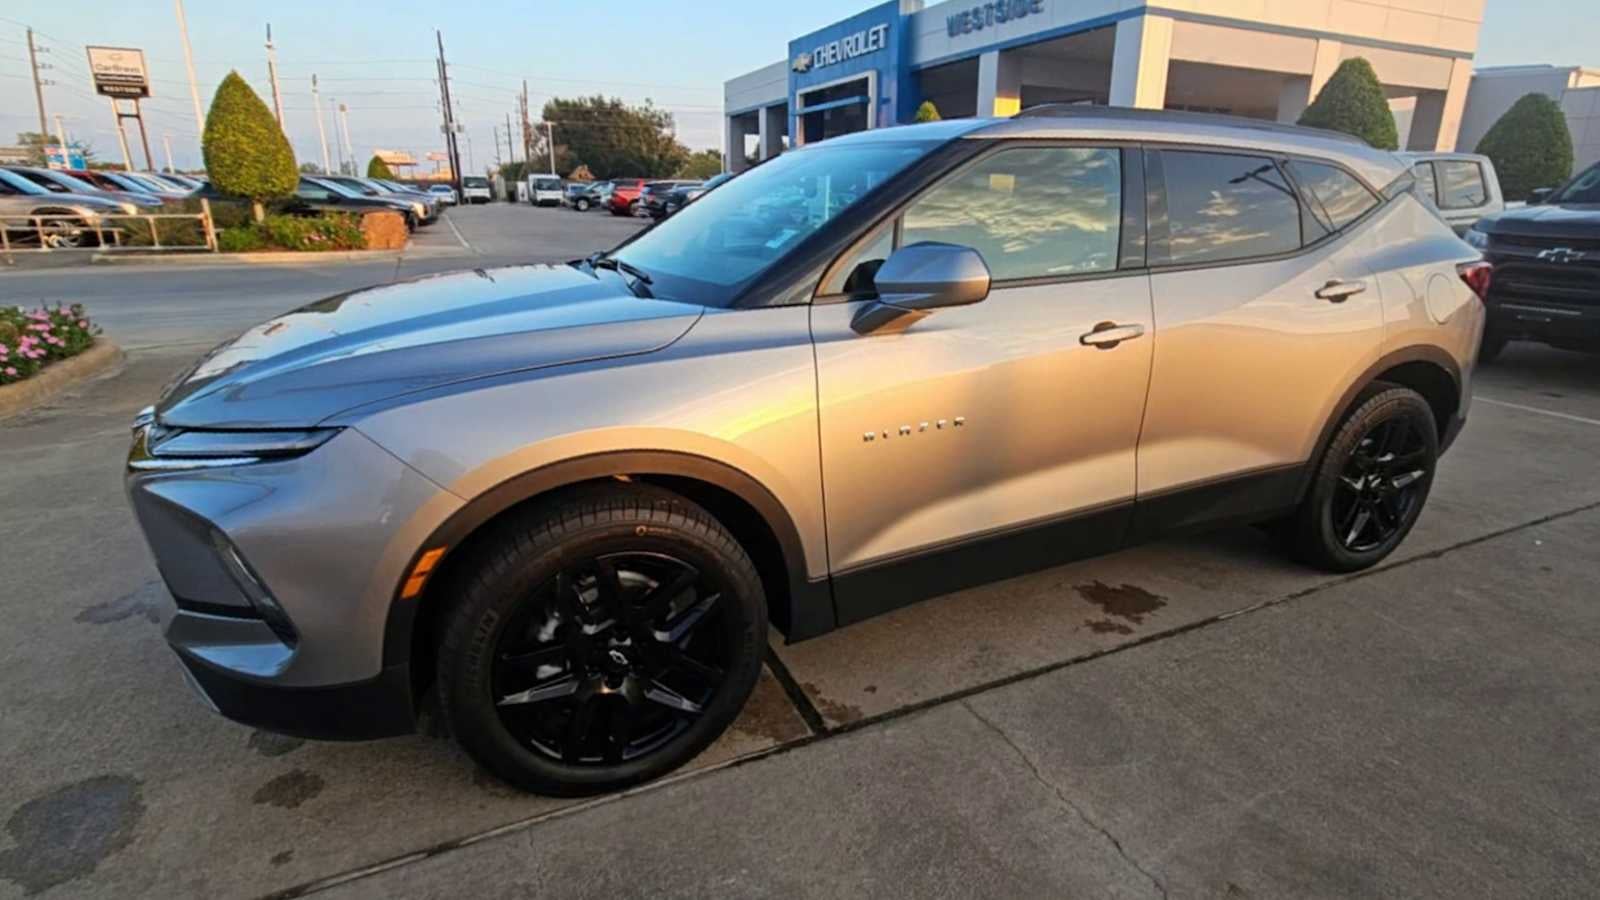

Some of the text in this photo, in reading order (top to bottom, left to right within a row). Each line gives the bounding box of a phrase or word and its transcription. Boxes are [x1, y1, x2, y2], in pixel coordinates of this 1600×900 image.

[946, 0, 1044, 37] WESTSIDE
[813, 23, 888, 69] CHEVROLET
[862, 416, 965, 442] BLAZER
